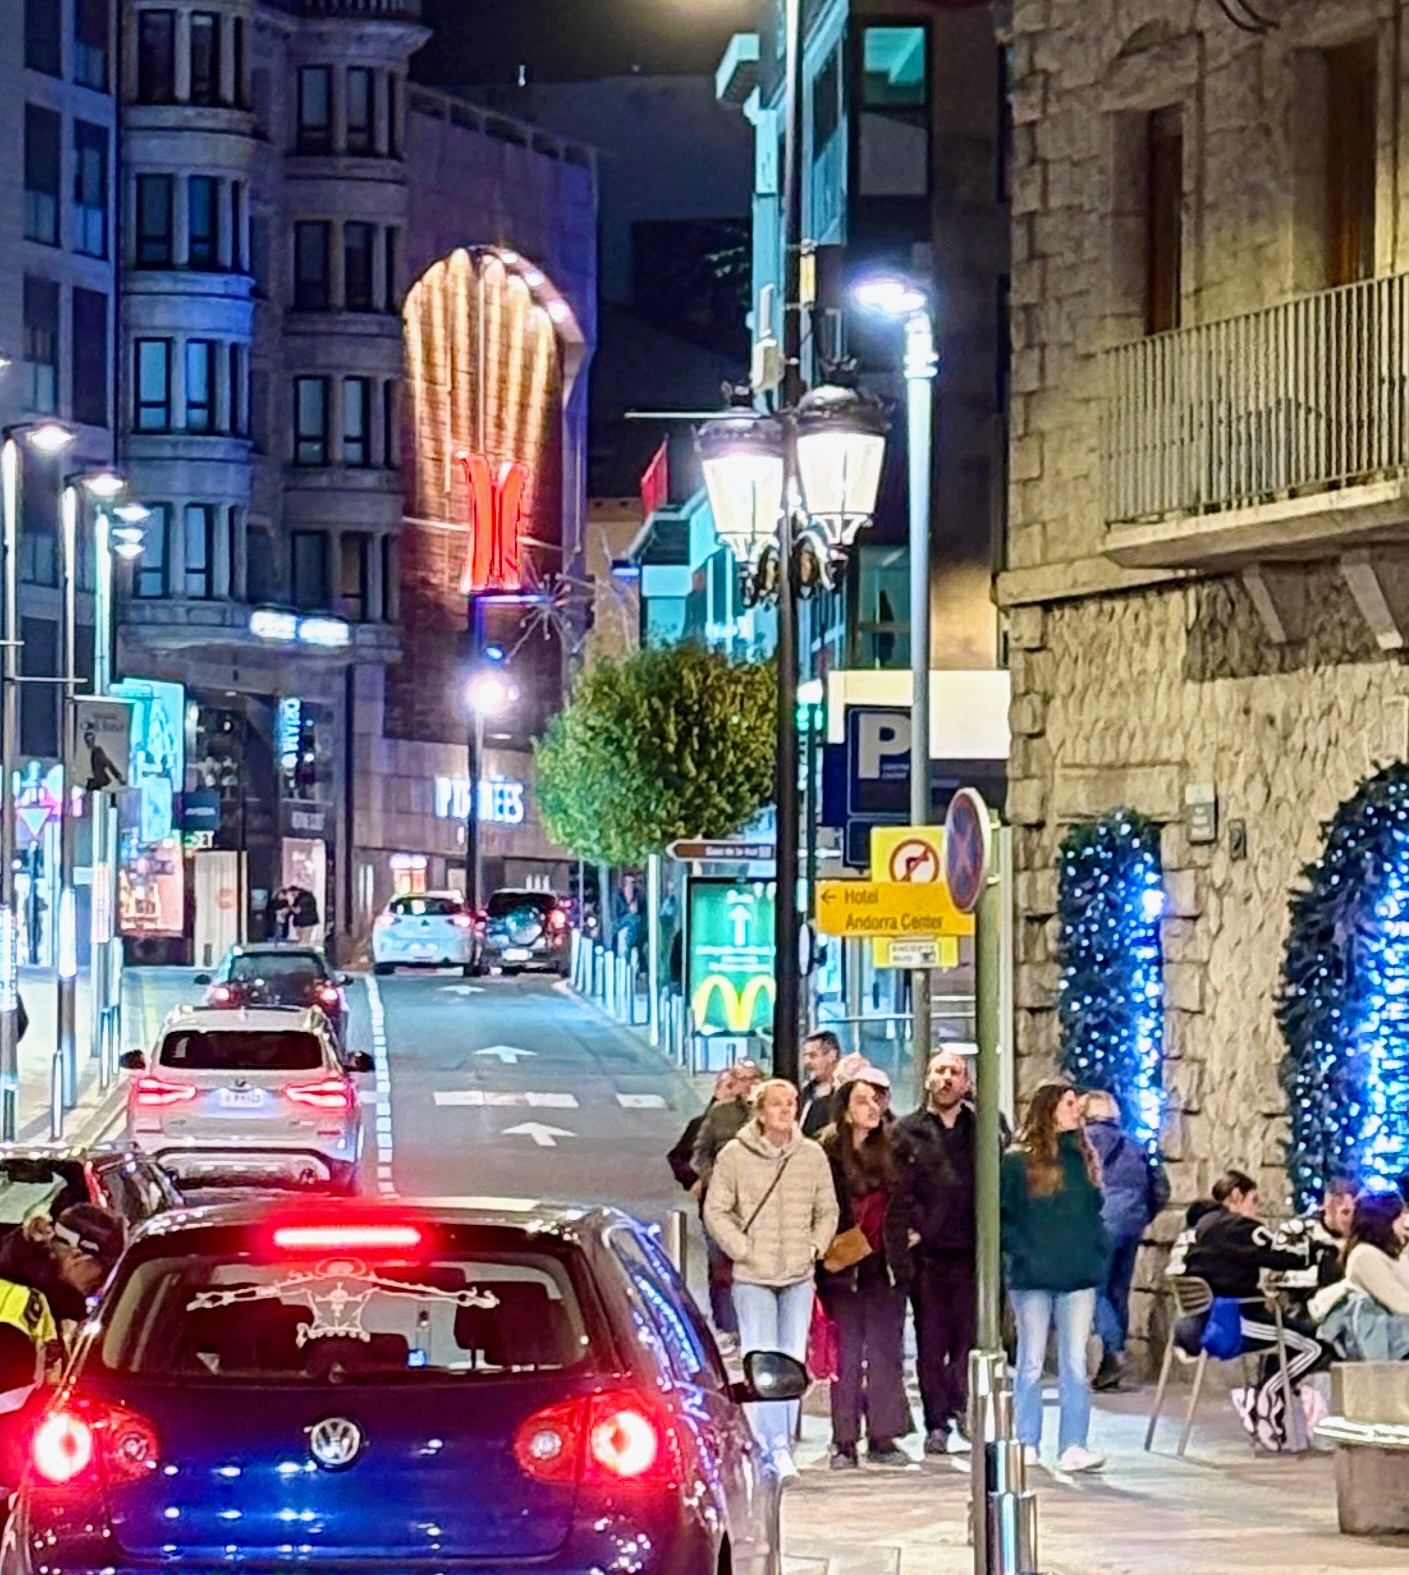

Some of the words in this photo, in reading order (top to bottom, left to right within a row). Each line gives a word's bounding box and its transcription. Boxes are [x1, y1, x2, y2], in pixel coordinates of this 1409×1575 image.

[858, 712, 913, 779] P
[844, 889, 879, 905] Hotel
[845, 913, 897, 931] Andorra
[901, 913, 943, 930] Center
